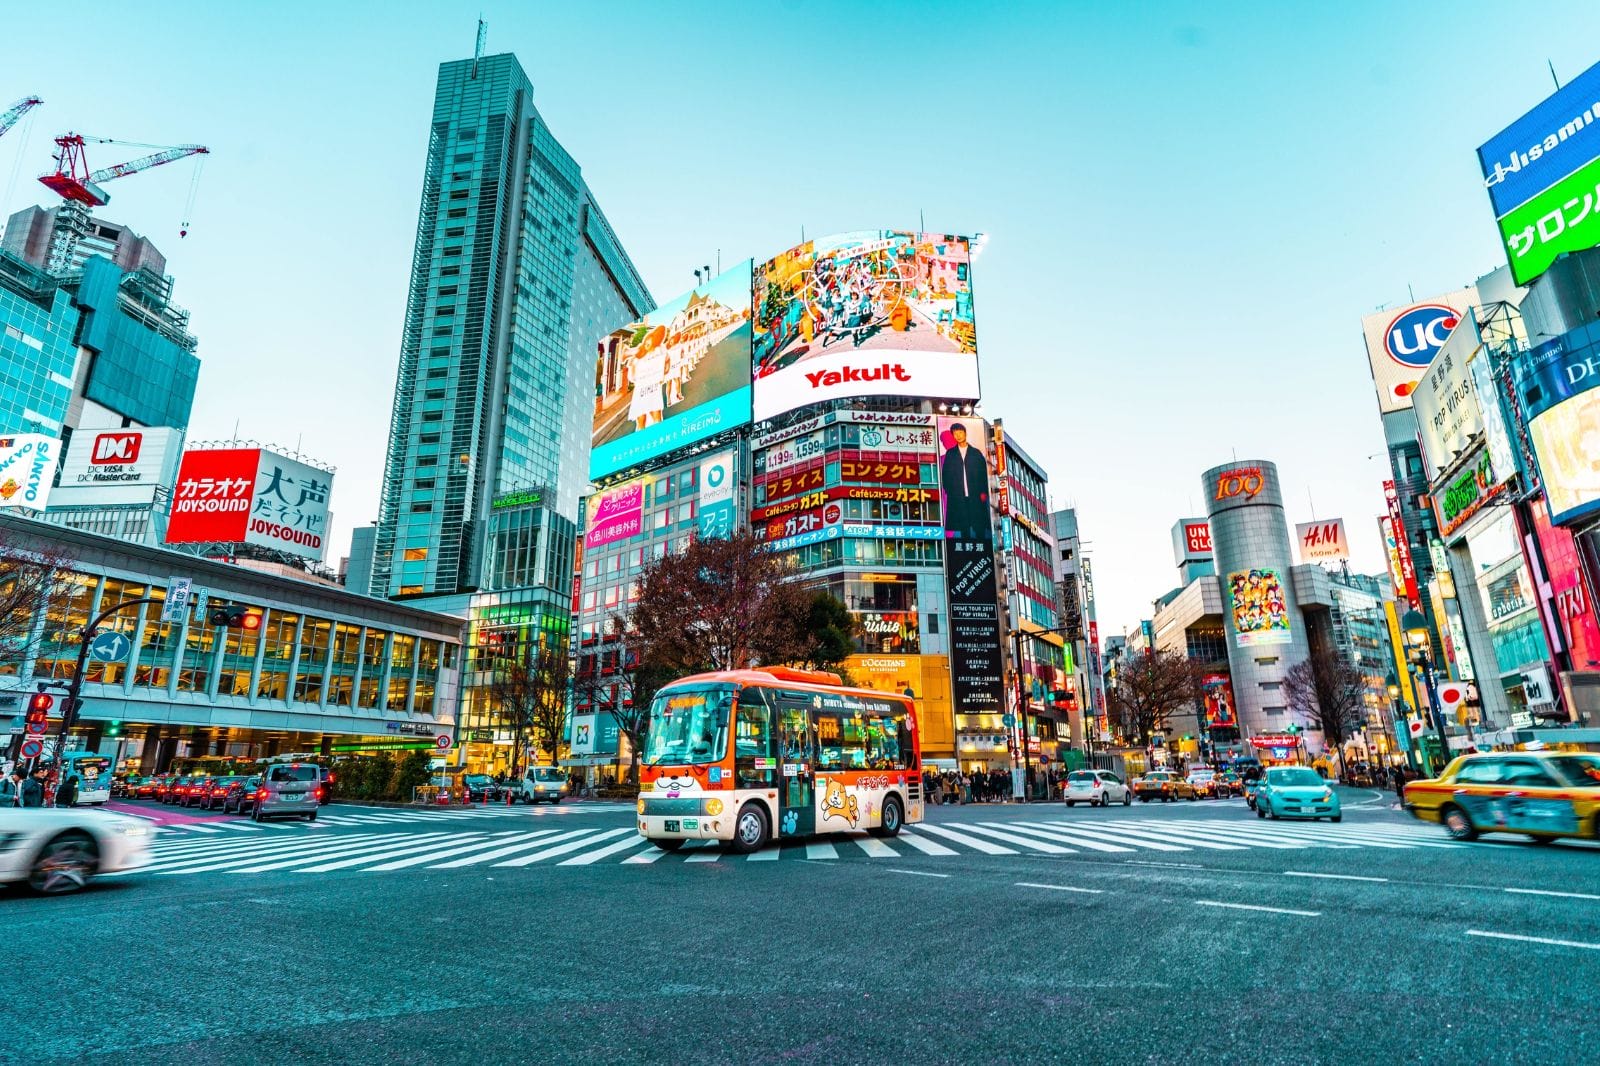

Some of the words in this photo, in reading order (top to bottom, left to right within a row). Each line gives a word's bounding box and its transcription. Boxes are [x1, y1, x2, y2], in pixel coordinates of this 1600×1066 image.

[805, 364, 912, 389] Yakult
[1447, 379, 1470, 413] VIRUS
[852, 412, 932, 424] しゃぶしゃぶバイキング
[759, 418, 820, 446] しゃぶしゃぶバイキング
[885, 430, 933, 445] しゃぶ葉
[95, 437, 136, 460] DC
[25, 441, 51, 501] SANKYO
[104, 465, 123, 473] VISA
[754, 457, 766, 468] 9F
[842, 461, 918, 480] コンタクト
[77, 474, 92, 482] DC
[92, 473, 141, 481] MasterCard
[179, 477, 252, 498] カラオケ
[257, 466, 329, 507] 大声
[767, 470, 824, 498] プライス
[1215, 474, 1265, 501] 109
[611, 497, 637, 513] クリニック
[800, 491, 829, 511] ガスト
[895, 488, 932, 503] ガスト
[175, 499, 249, 513] JOYSOUND
[249, 518, 322, 549] JOYSOUND
[593, 518, 639, 542] 品川美容外科
[754, 527, 767, 540] 7F
[785, 513, 820, 537] ガスト
[875, 526, 941, 537] 英会話イーオン
[1304, 523, 1338, 548] H&M
[955, 542, 985, 552] 星野源
[861, 658, 906, 667] L'OCCITANE
